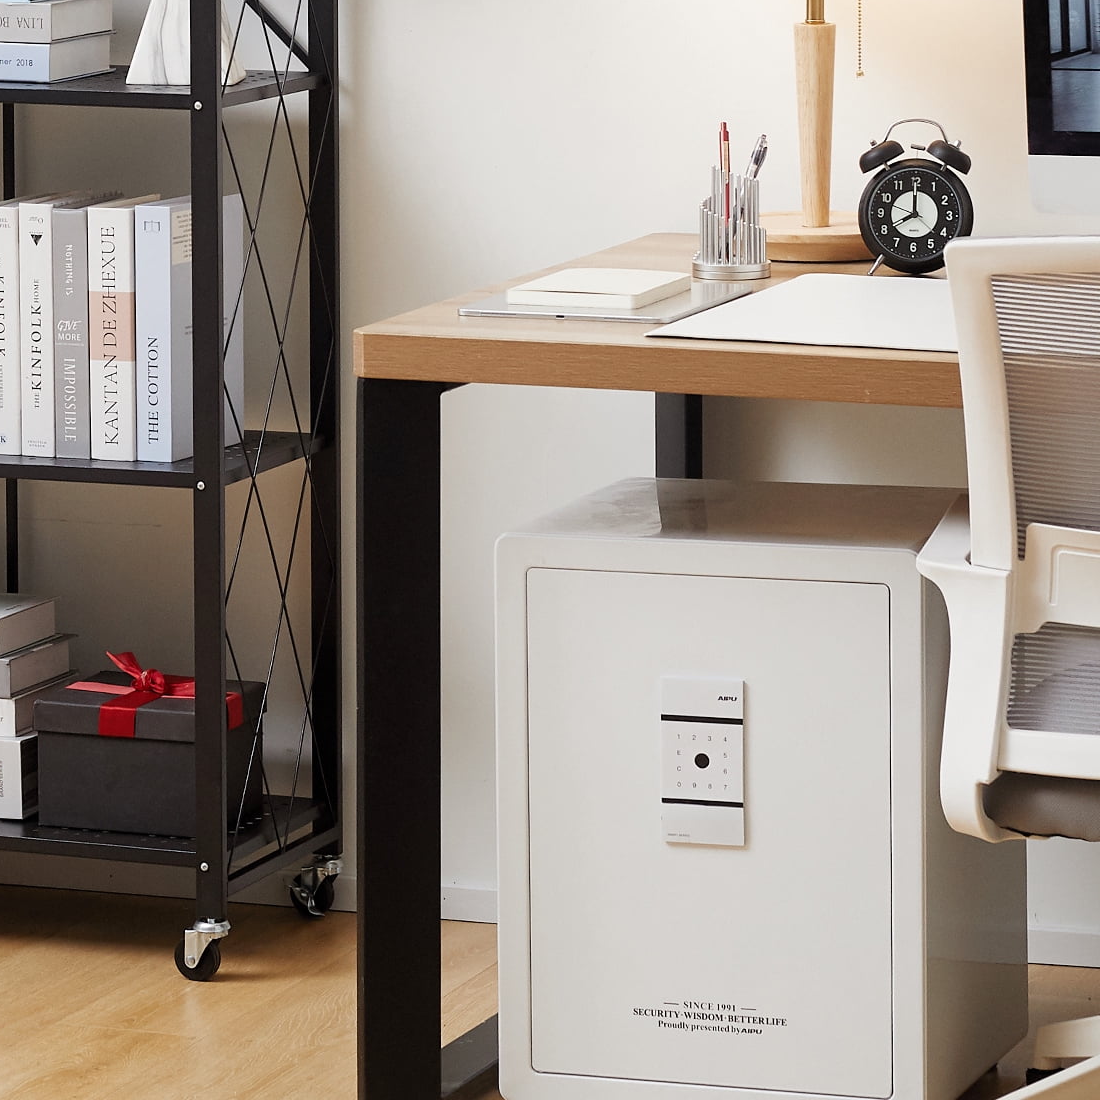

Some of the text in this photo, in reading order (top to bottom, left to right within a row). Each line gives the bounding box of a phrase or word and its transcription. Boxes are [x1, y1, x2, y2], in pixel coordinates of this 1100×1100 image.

[16, 16, 44, 30] LINA
[16, 58, 33, 67] 2018
[894, 180, 936, 192] 11 1
[881, 192, 949, 205] 10 2
[877, 208, 953, 221] 9 3
[880, 225, 947, 237] 8 4
[893, 237, 935, 252] 7 6 5
[57, 319, 82, 331] GIVE
[58, 332, 82, 341] MORE
[100, 226, 119, 445] KANTAN DE ZHEXUE
[30, 305, 42, 391] KINFOLK
[147, 336, 159, 445] THE COTTON
[63, 358, 77, 442] IMPOSSIBLE
[683, 1001, 736, 1012] SINCE 1991
[658, 1020, 689, 1031] Proudly
[690, 1022, 730, 1033] presented
[731, 1025, 740, 1035] by
